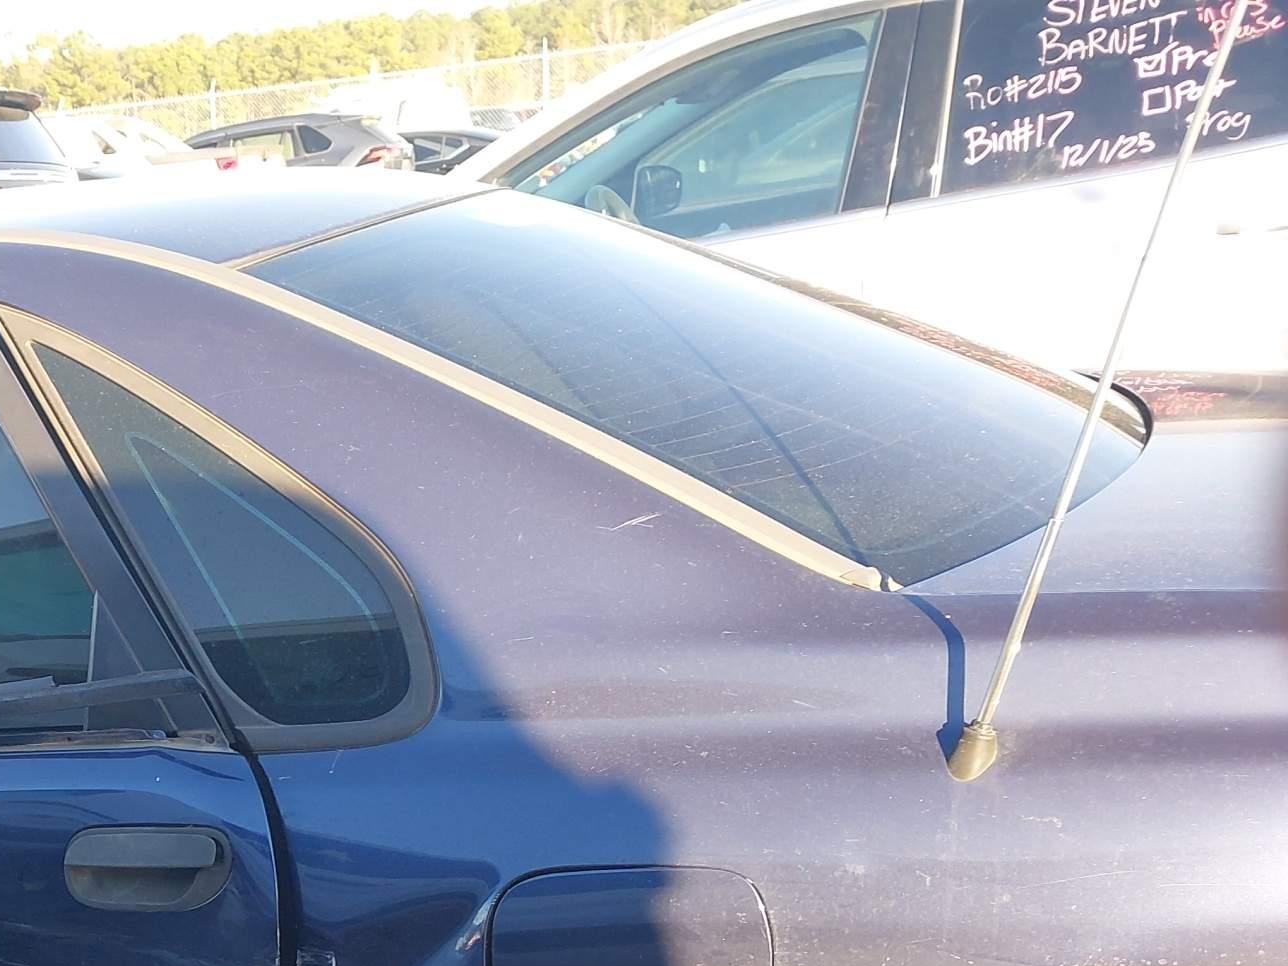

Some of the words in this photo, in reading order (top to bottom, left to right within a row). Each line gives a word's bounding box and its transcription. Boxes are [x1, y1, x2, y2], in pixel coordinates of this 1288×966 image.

[1038, 10, 1187, 66] BARNETT
[1174, 79, 1238, 110] Pot
[964, 111, 1075, 165] Bin#17
[1062, 132, 1156, 169] 12/1/25
